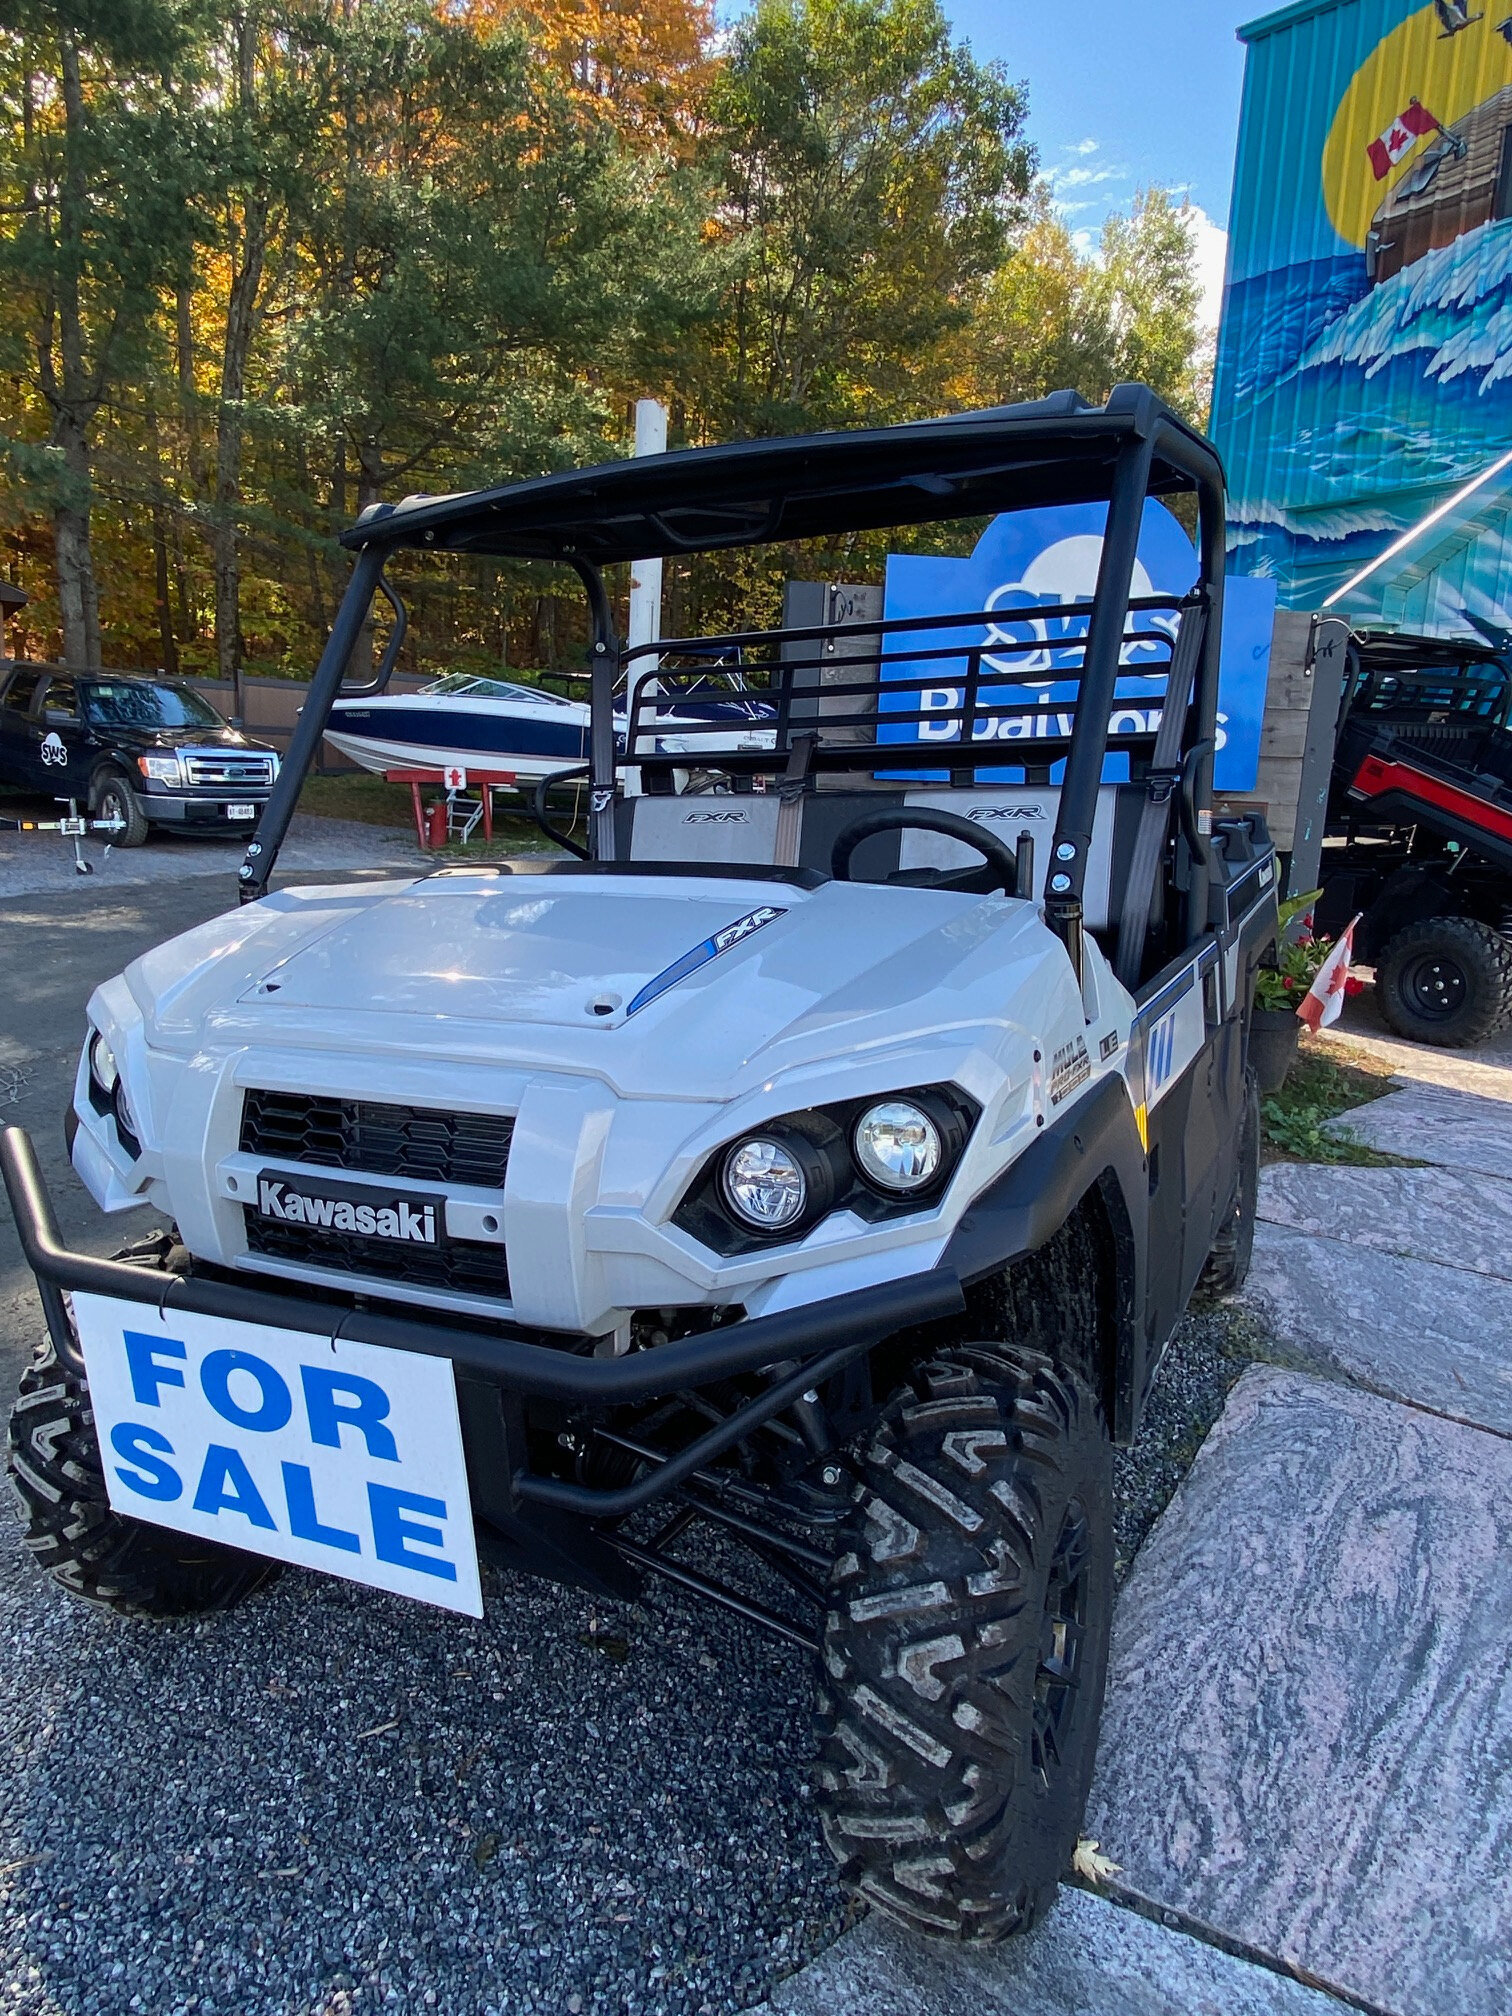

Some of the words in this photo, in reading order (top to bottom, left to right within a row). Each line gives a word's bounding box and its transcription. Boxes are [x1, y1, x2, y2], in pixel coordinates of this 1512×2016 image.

[41, 742, 68, 766] SWS
[682, 809, 750, 823] FXR
[965, 805, 1047, 820] FXR
[717, 907, 777, 950] FXR
[1100, 1032, 1118, 1060] LE
[260, 1180, 437, 1244] Kawasaki
[123, 1330, 402, 1463] FOR
[111, 1422, 458, 1582] SALE
